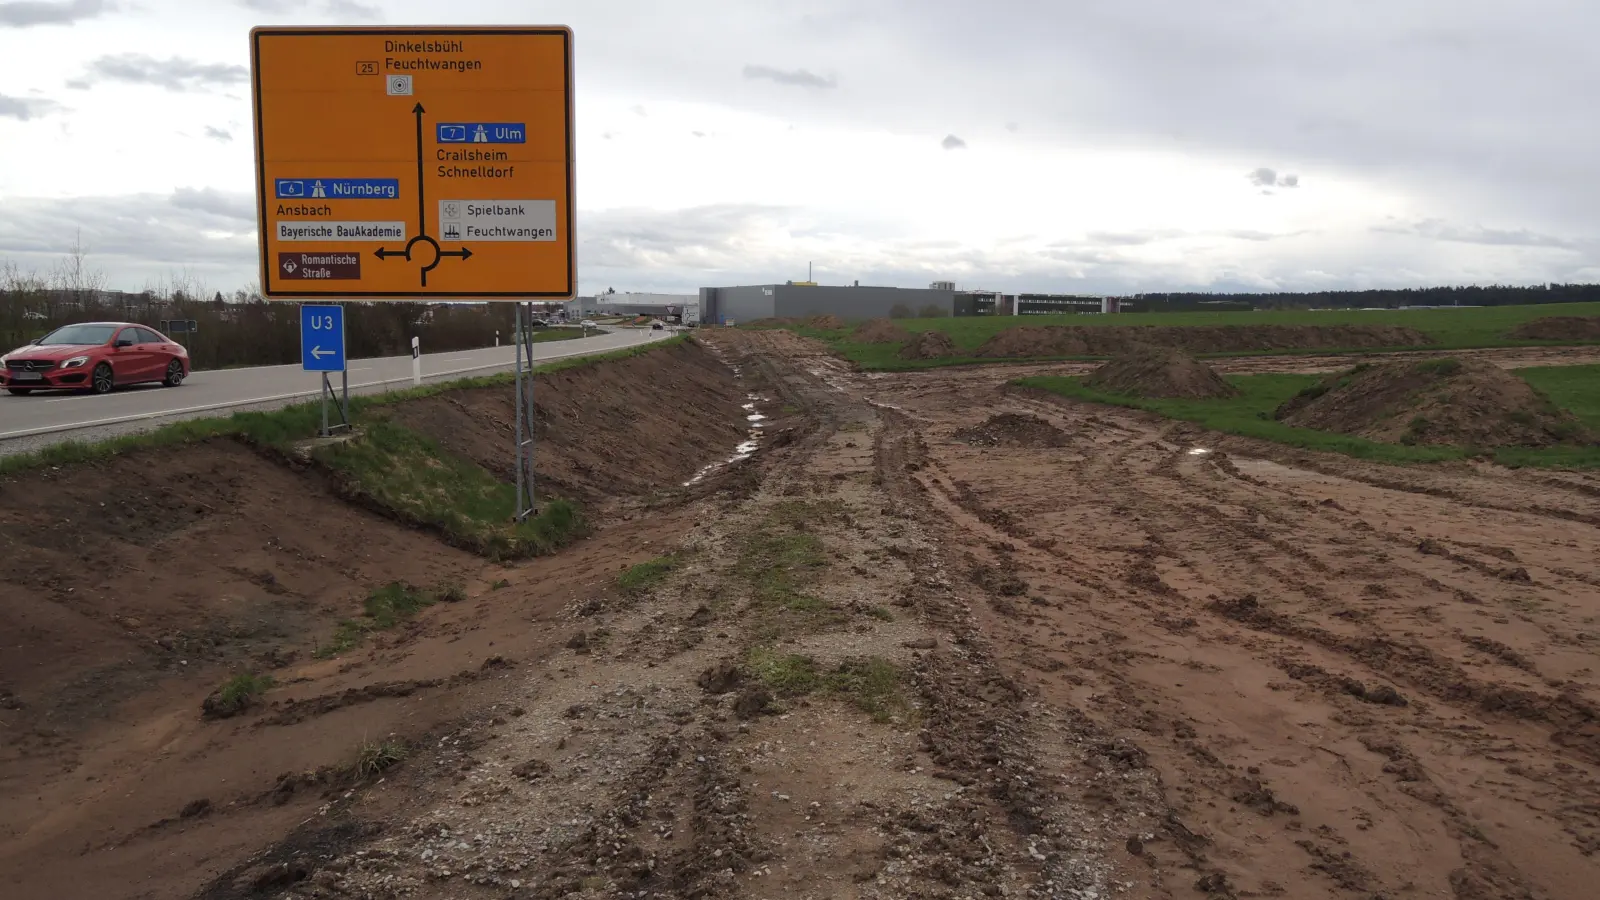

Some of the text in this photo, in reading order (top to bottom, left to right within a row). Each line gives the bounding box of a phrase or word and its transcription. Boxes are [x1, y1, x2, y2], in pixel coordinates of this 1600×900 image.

[385, 41, 463, 53] Dinkelsbühl
[362, 64, 373, 73] 25
[385, 58, 481, 72] Feuchtwangen
[450, 127, 522, 140] 7 Ulm
[436, 149, 508, 161] Crailsheim
[437, 166, 514, 178] Schnelldorf
[288, 183, 395, 198] 6 Nürnberg
[276, 204, 332, 216] Ansbach
[467, 205, 525, 218] Spielbank
[281, 226, 402, 240] Bayerische BauAkademie
[467, 226, 553, 239] Feuchtwangen
[301, 254, 357, 265] Romantische
[302, 268, 331, 278] Straße
